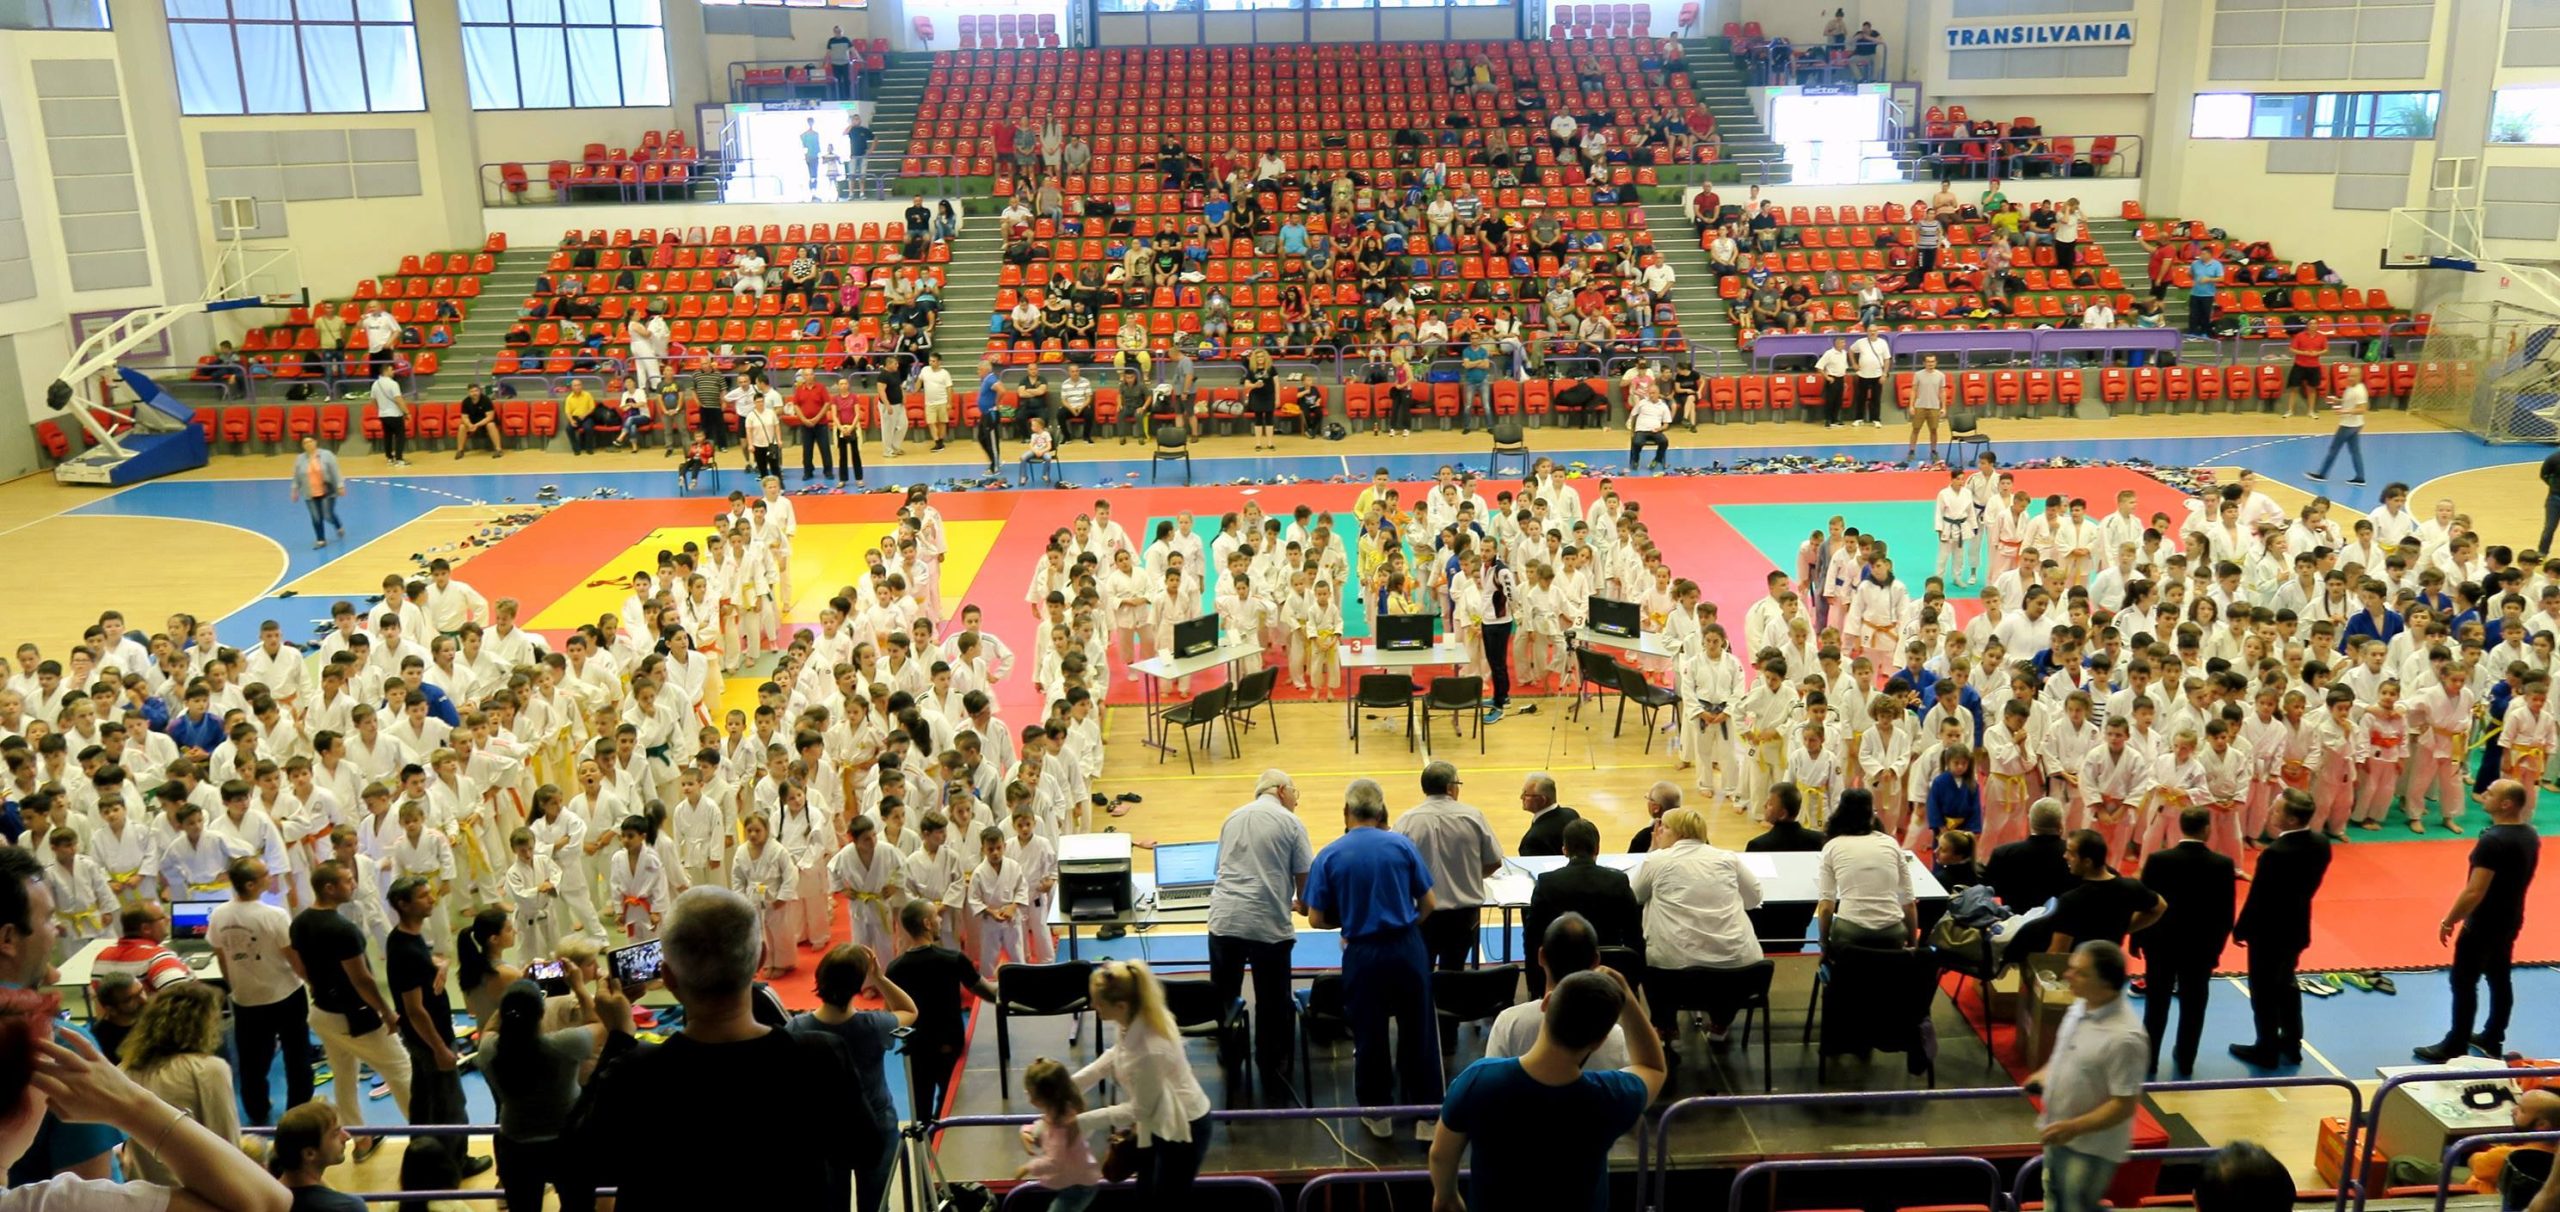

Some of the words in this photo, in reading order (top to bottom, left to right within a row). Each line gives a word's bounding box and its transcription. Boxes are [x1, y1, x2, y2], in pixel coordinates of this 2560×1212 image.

[1947, 23, 2131, 46] TRANSILVANIA
[1575, 616, 1584, 626] 3
[1352, 640, 1361, 651] 3
